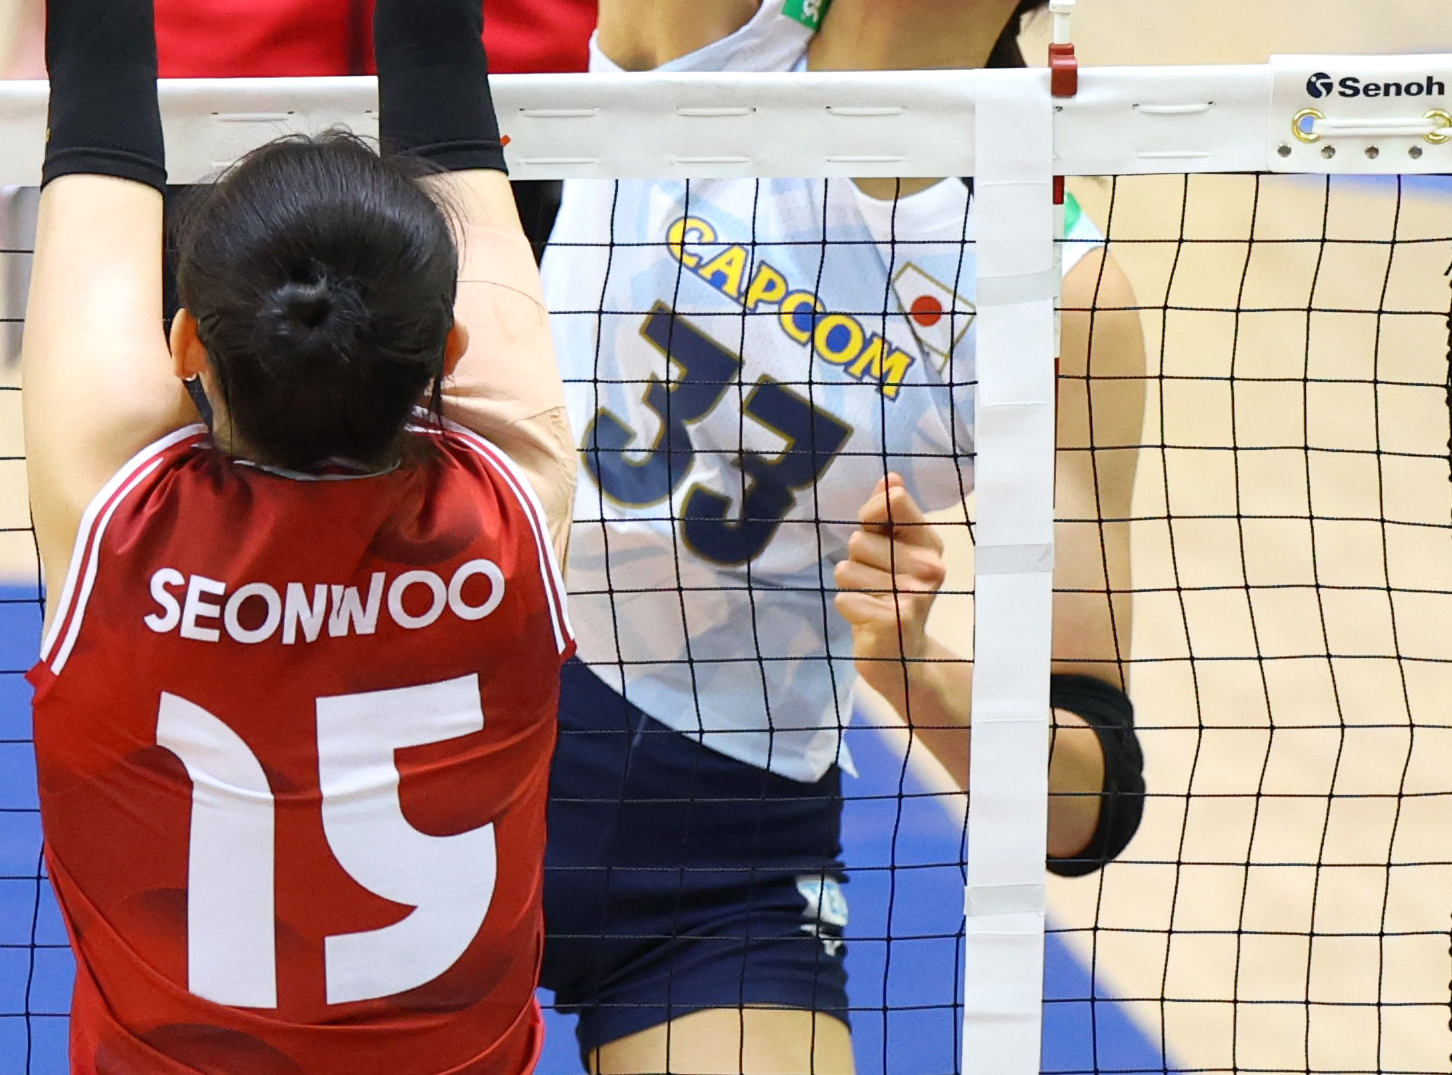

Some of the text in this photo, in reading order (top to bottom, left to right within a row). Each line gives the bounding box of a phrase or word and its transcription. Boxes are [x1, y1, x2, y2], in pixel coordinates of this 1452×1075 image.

[1337, 76, 1445, 98] Senoh
[666, 215, 917, 402] CAPCOM
[580, 299, 855, 568] 33
[143, 558, 506, 646] SEONWOO
[155, 672, 497, 1010] 15
